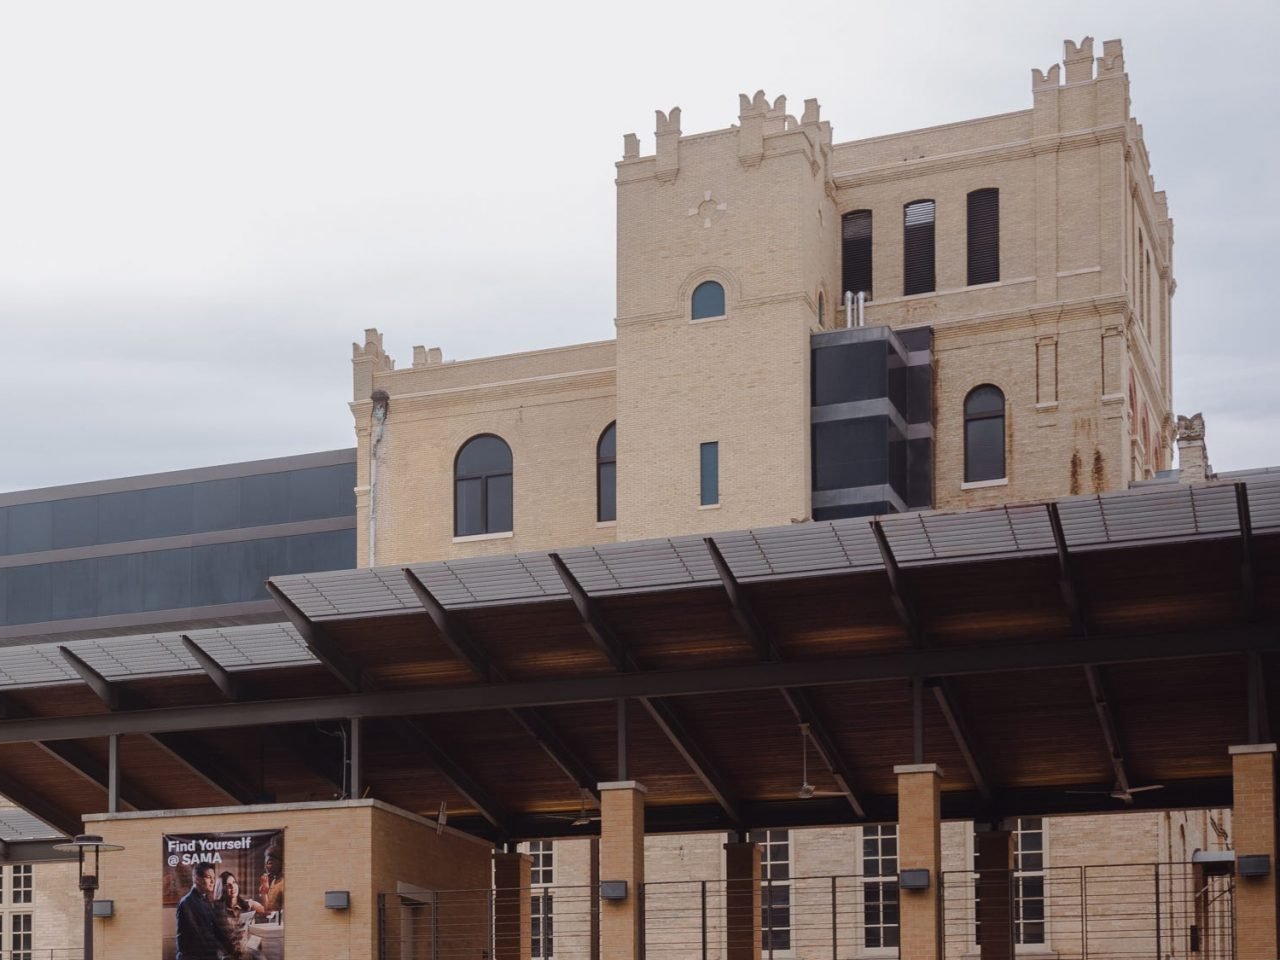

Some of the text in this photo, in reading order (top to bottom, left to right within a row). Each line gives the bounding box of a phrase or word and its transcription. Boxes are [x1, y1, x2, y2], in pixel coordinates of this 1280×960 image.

[168, 837, 252, 852] Find Yourself
[168, 852, 222, 867] @ SAMA
